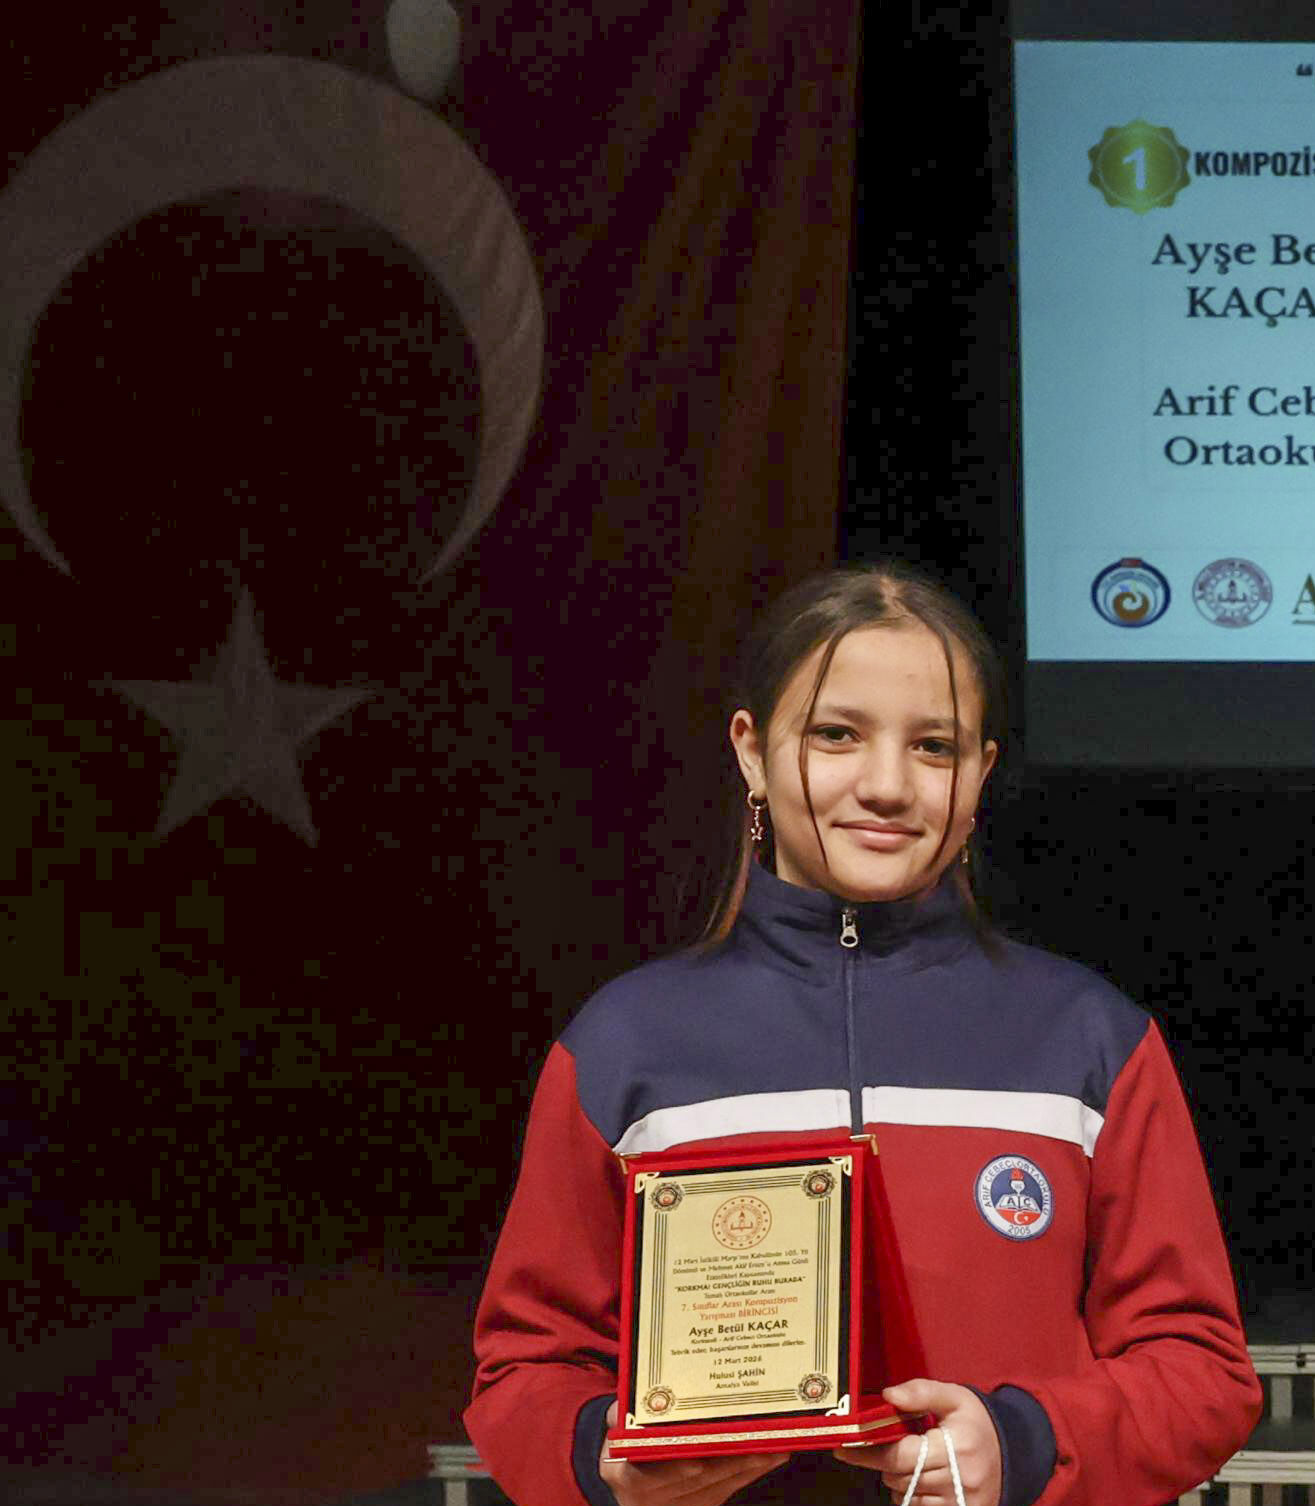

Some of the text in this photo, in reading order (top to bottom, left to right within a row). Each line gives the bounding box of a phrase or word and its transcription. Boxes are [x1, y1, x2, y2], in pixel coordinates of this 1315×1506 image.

[1122, 146, 1147, 190] 1
[1152, 234, 1256, 275] Ayşe
[1153, 387, 1237, 417] Arif
[689, 1319, 789, 1337] Ayşe Betül KAÇAR
